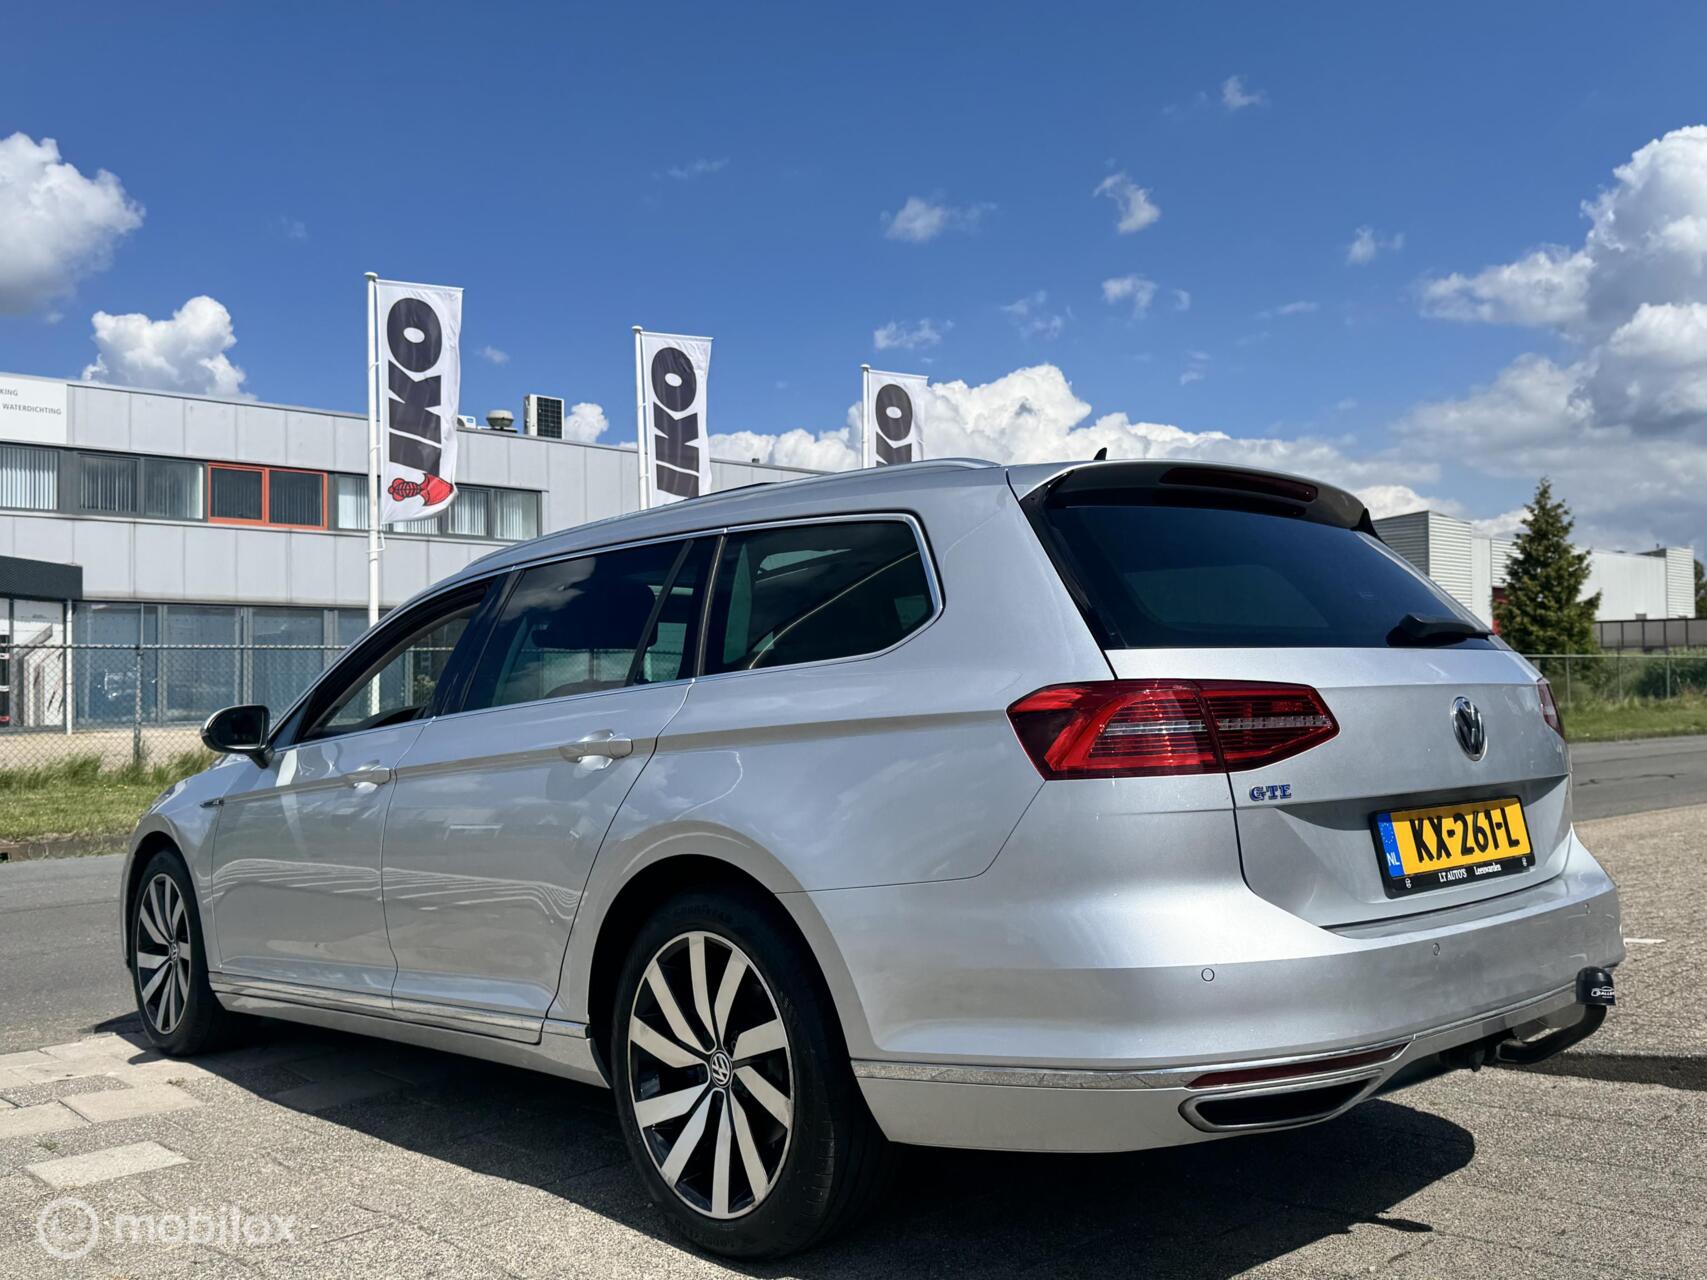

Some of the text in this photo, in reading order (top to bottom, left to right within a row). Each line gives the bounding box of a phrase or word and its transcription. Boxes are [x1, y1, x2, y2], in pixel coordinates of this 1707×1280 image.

[387, 298, 442, 476] IKO
[2, 403, 62, 415] WATERDICHTING
[651, 347, 699, 499] IKO
[1250, 784, 1292, 801] GTE
[1409, 807, 1520, 863] KX-261-L
[1386, 853, 1401, 866] NL
[1438, 872, 1447, 883] LT
